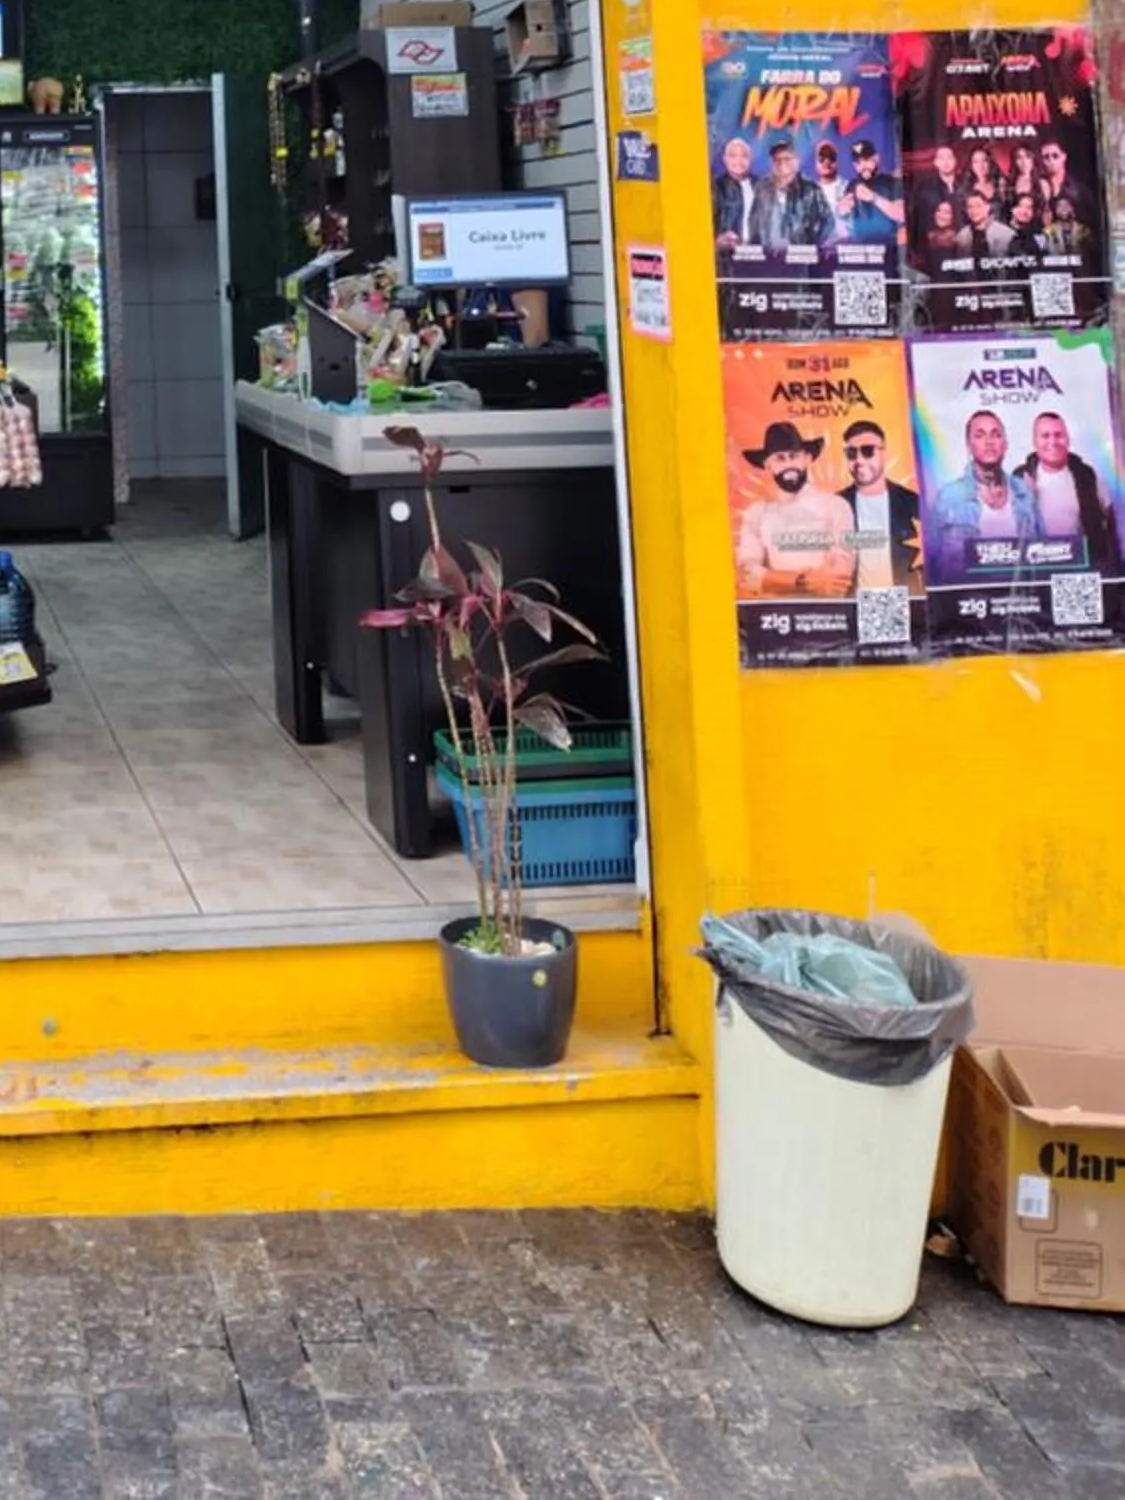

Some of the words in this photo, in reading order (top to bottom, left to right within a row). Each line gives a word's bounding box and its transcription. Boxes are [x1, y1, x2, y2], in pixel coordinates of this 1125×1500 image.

[818, 70, 842, 85] DO
[742, 85, 870, 139] MORAL
[961, 125, 1038, 139] ARENA
[468, 231, 508, 244] Caixa
[511, 229, 546, 242] Livre
[739, 292, 768, 312] zig
[955, 294, 979, 311] zig
[807, 355, 831, 372] 31
[963, 366, 1063, 395] ARENA
[771, 379, 873, 409] ARENA
[979, 392, 1041, 407] SHOW
[787, 405, 850, 418] SHOW
[959, 599, 987, 620] zig
[760, 613, 791, 635] zig
